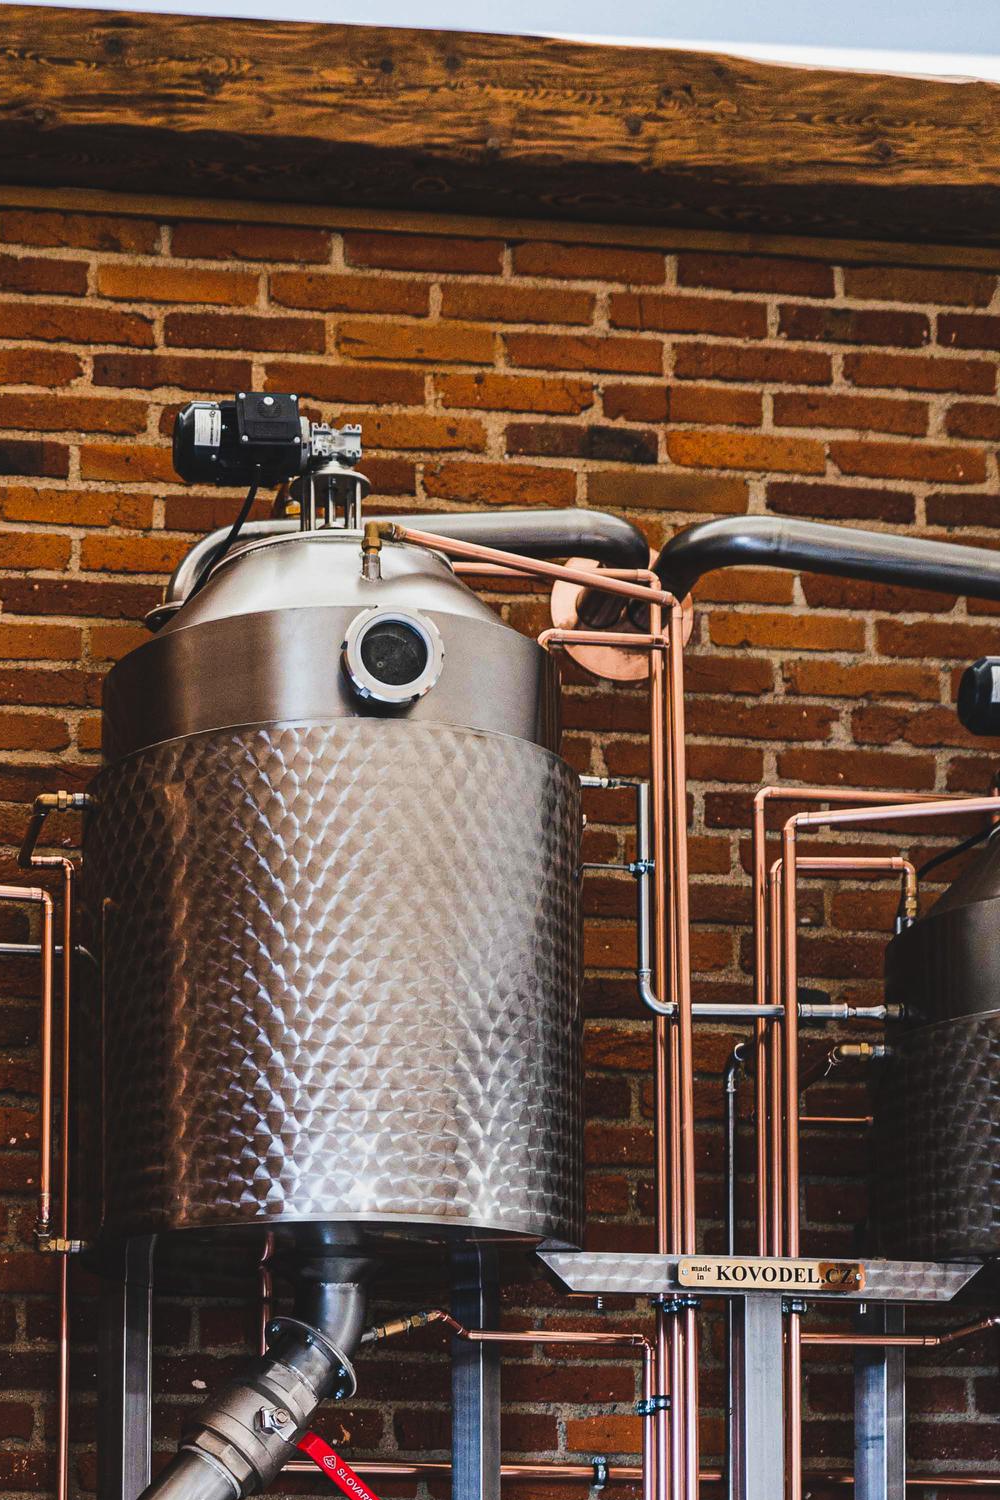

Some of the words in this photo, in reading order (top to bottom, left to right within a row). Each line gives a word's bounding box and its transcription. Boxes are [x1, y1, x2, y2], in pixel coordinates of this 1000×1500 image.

[691, 1264, 712, 1272] made
[696, 1272, 705, 1280] in
[716, 1265, 853, 1285] KOVODEL.CZ
